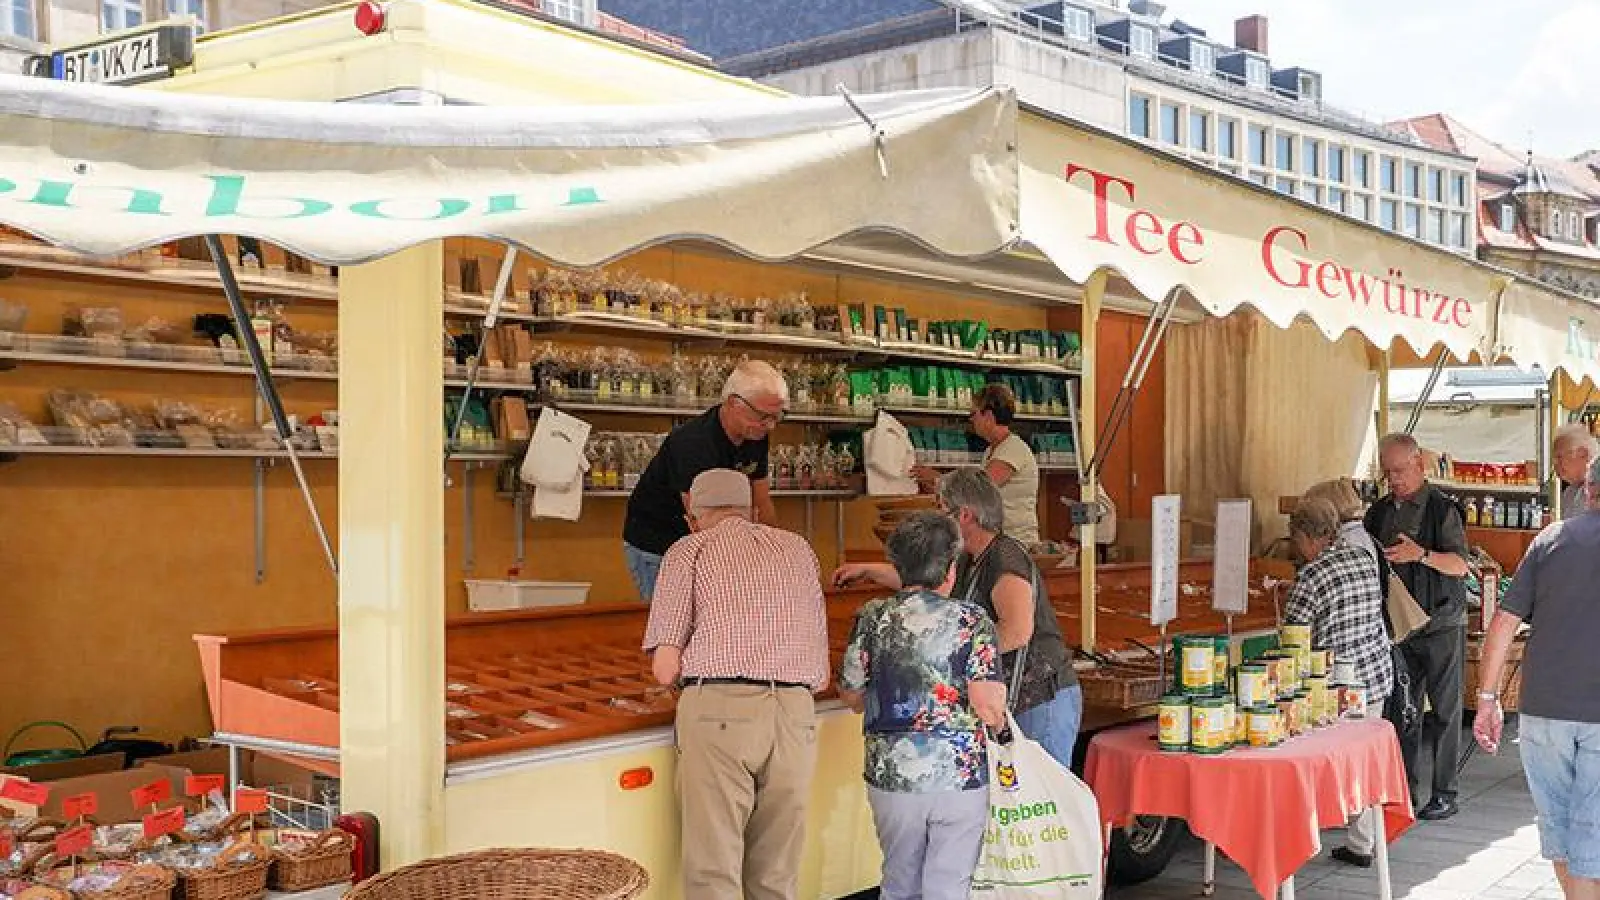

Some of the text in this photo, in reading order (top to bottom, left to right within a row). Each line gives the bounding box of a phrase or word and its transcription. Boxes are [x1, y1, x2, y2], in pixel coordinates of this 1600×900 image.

[65, 37, 154, 82] BT VK 71
[1065, 163, 1473, 329] Tee Gewürze
